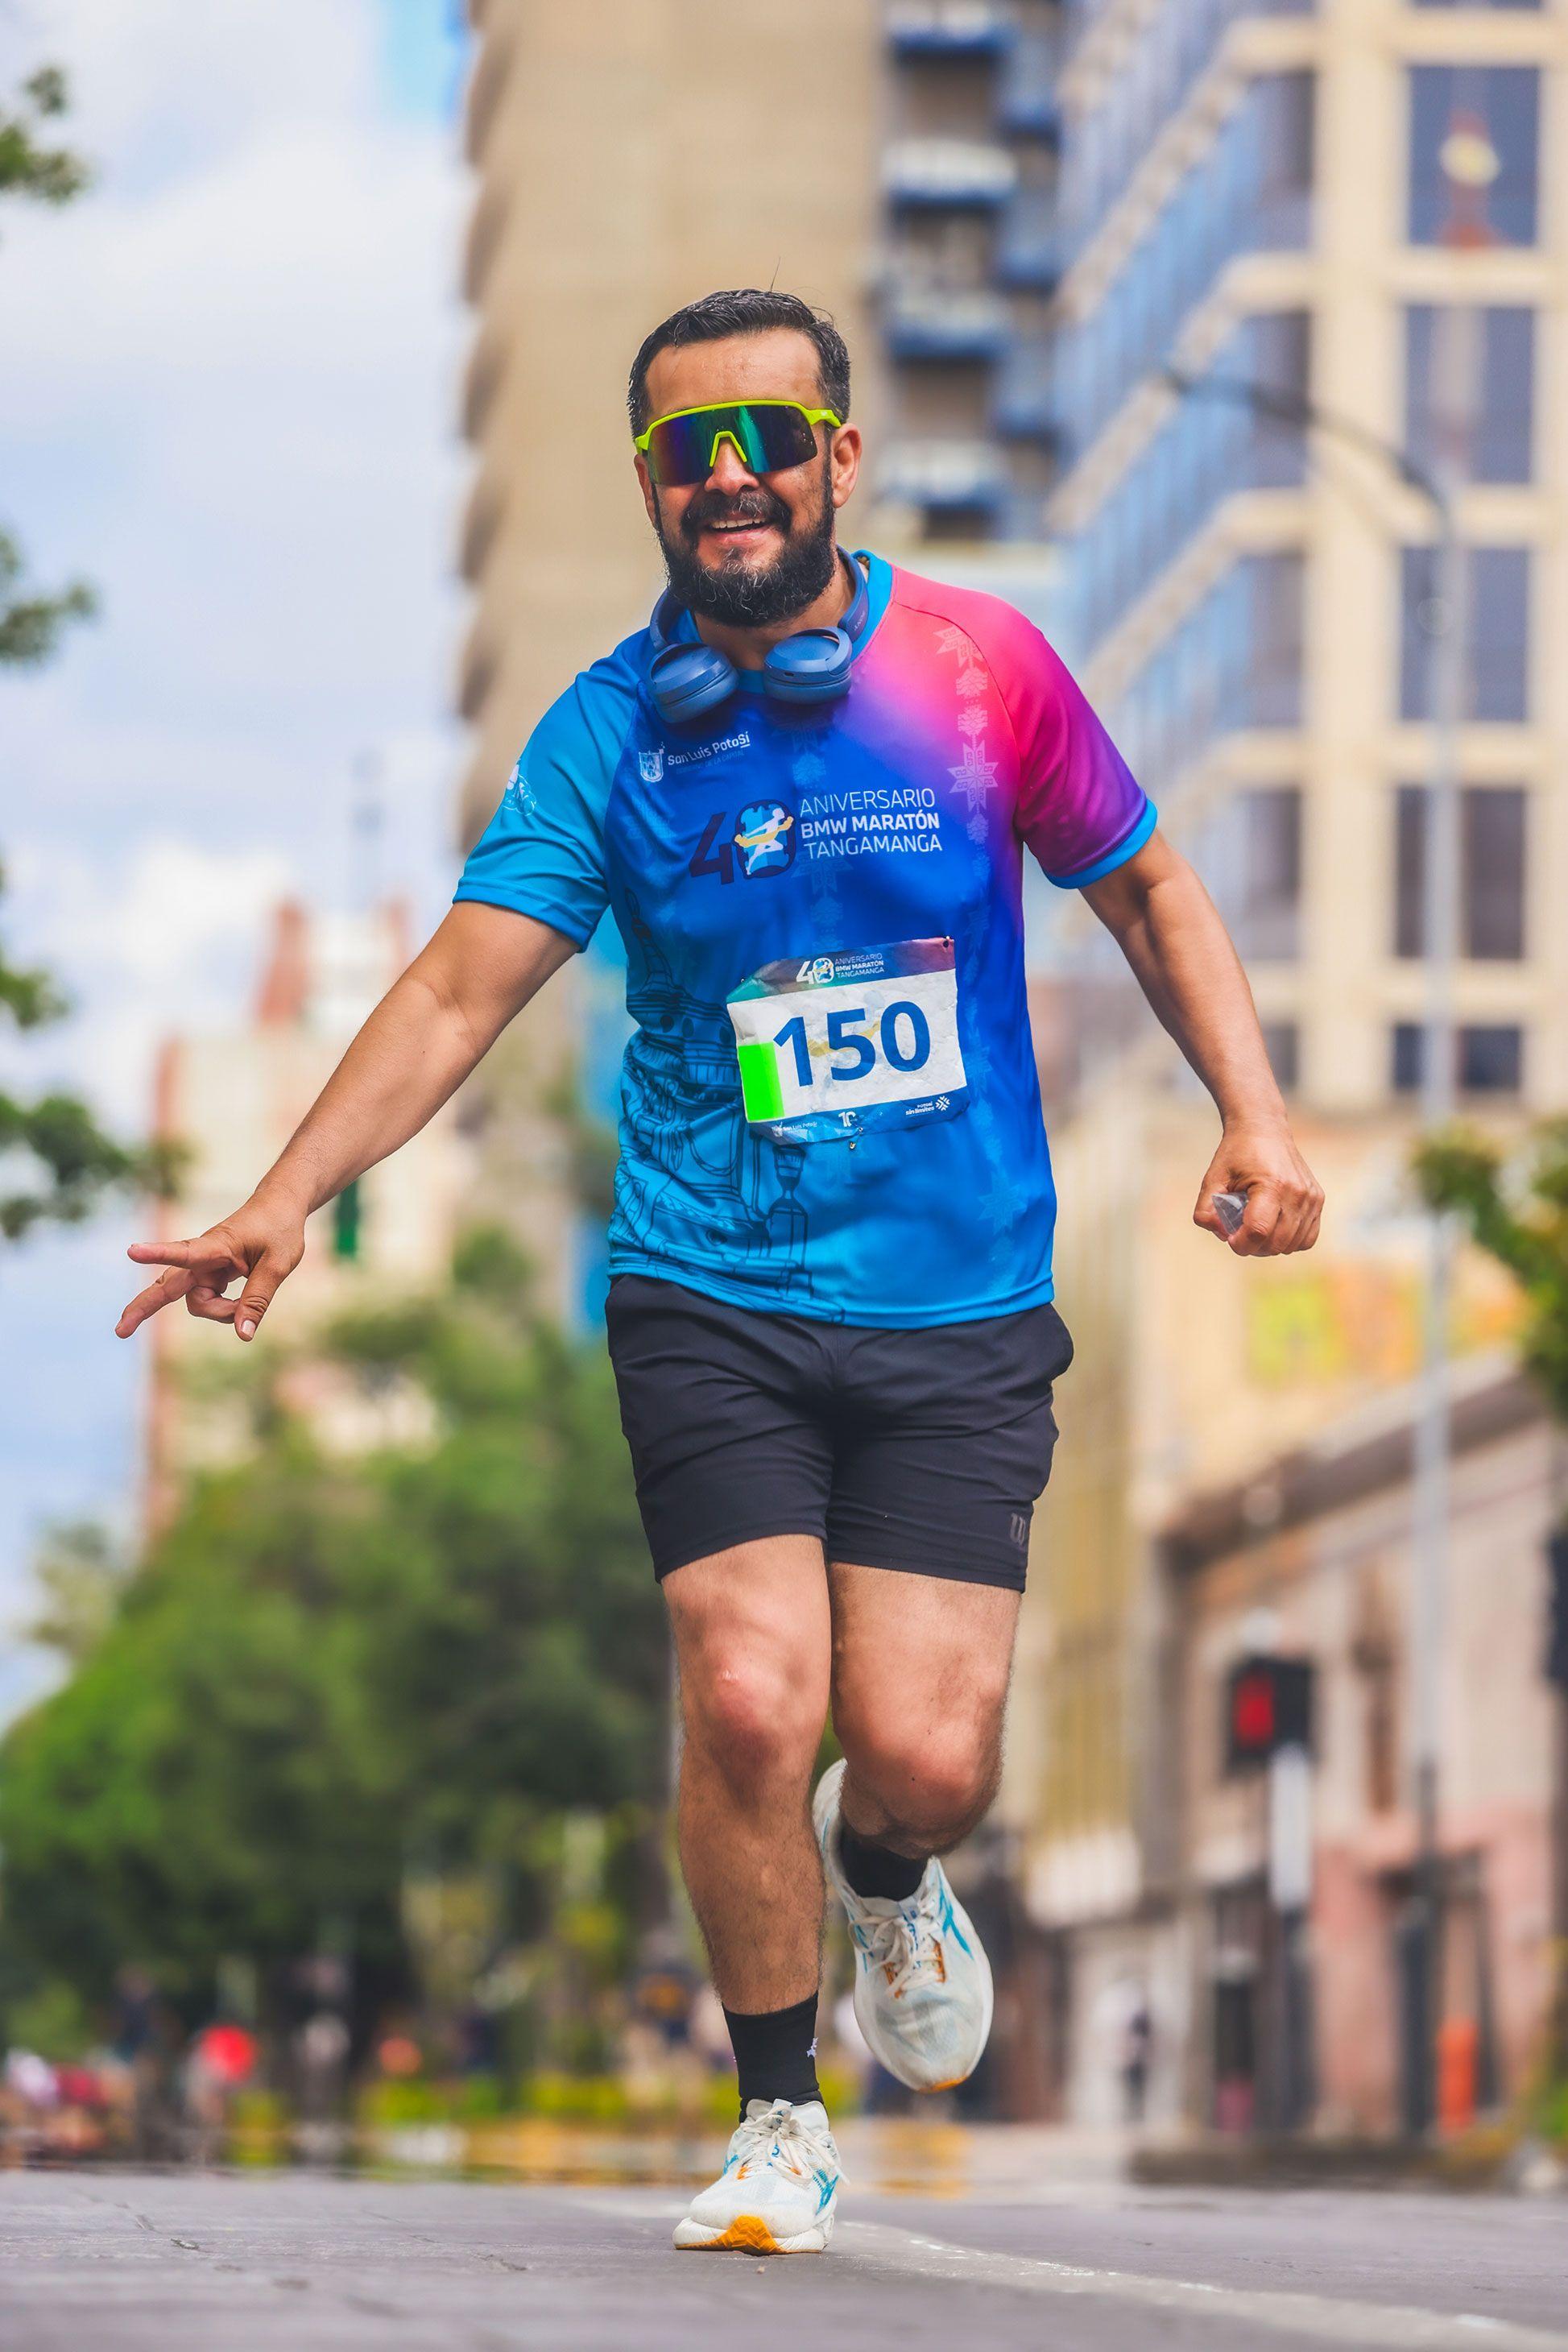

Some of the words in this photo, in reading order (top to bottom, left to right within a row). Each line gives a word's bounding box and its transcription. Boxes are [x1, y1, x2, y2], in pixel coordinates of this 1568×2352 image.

[668, 754, 689, 765] San
[687, 747, 712, 761] Luis
[800, 788, 935, 818] ANIVERSARIO
[801, 817, 847, 839] BMW
[852, 810, 941, 833] MARATÓN
[804, 834, 943, 859] TANGAMANGA
[834, 952, 883, 965] ANIVERSARIO
[835, 964, 851, 972] BMW
[851, 959, 884, 970] MARATÓN
[836, 967, 885, 978] TANGAMANGA
[772, 1000, 931, 1087] 150
